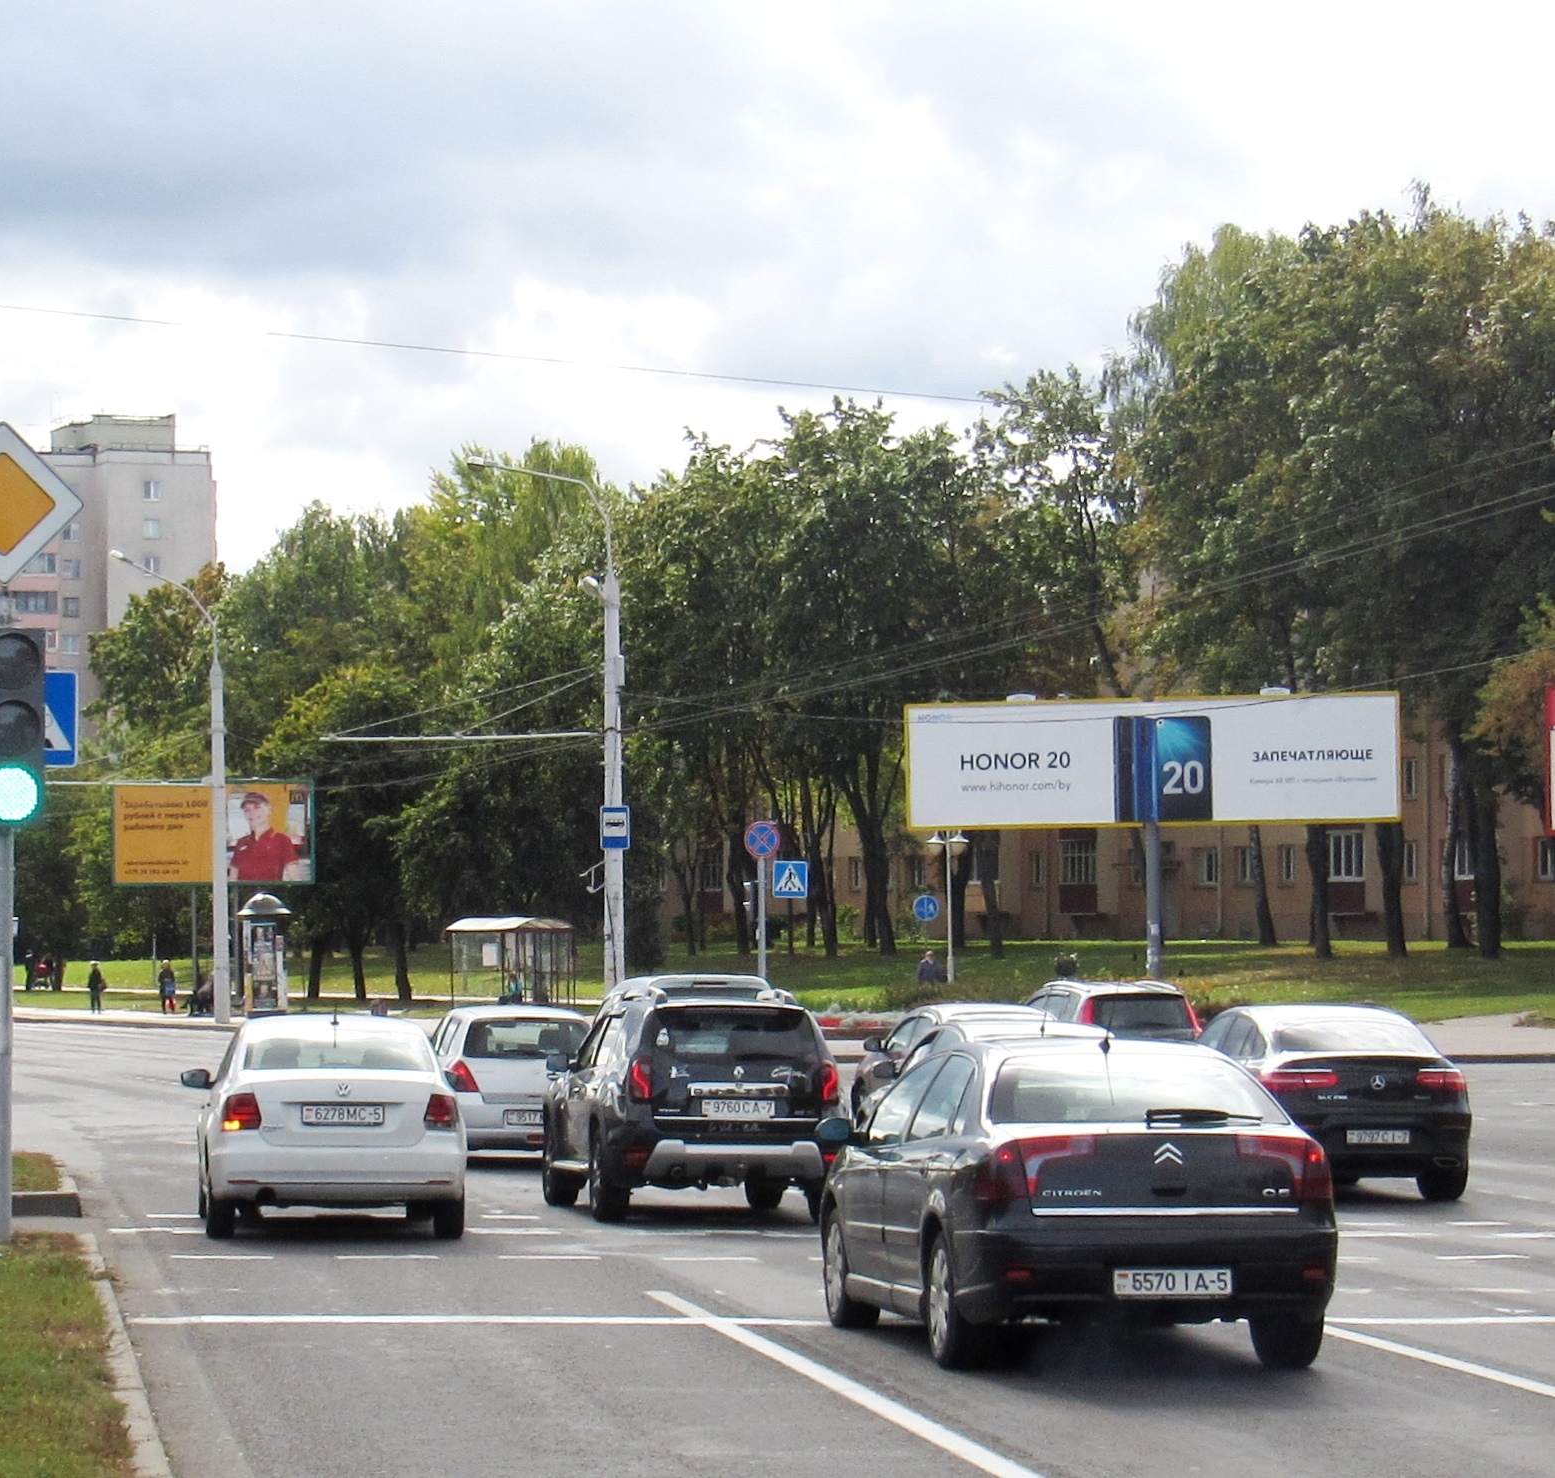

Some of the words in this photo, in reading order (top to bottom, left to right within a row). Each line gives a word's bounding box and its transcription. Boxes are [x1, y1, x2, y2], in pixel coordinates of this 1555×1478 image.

[960, 752, 1040, 771] HONOR
[1047, 751, 1071, 768] 20
[1252, 749, 1373, 762] ЗАПЕЧАТЛЯЮЩЕ
[1162, 761, 1204, 794] 20
[961, 780, 1071, 792] www.hihonor.com/by
